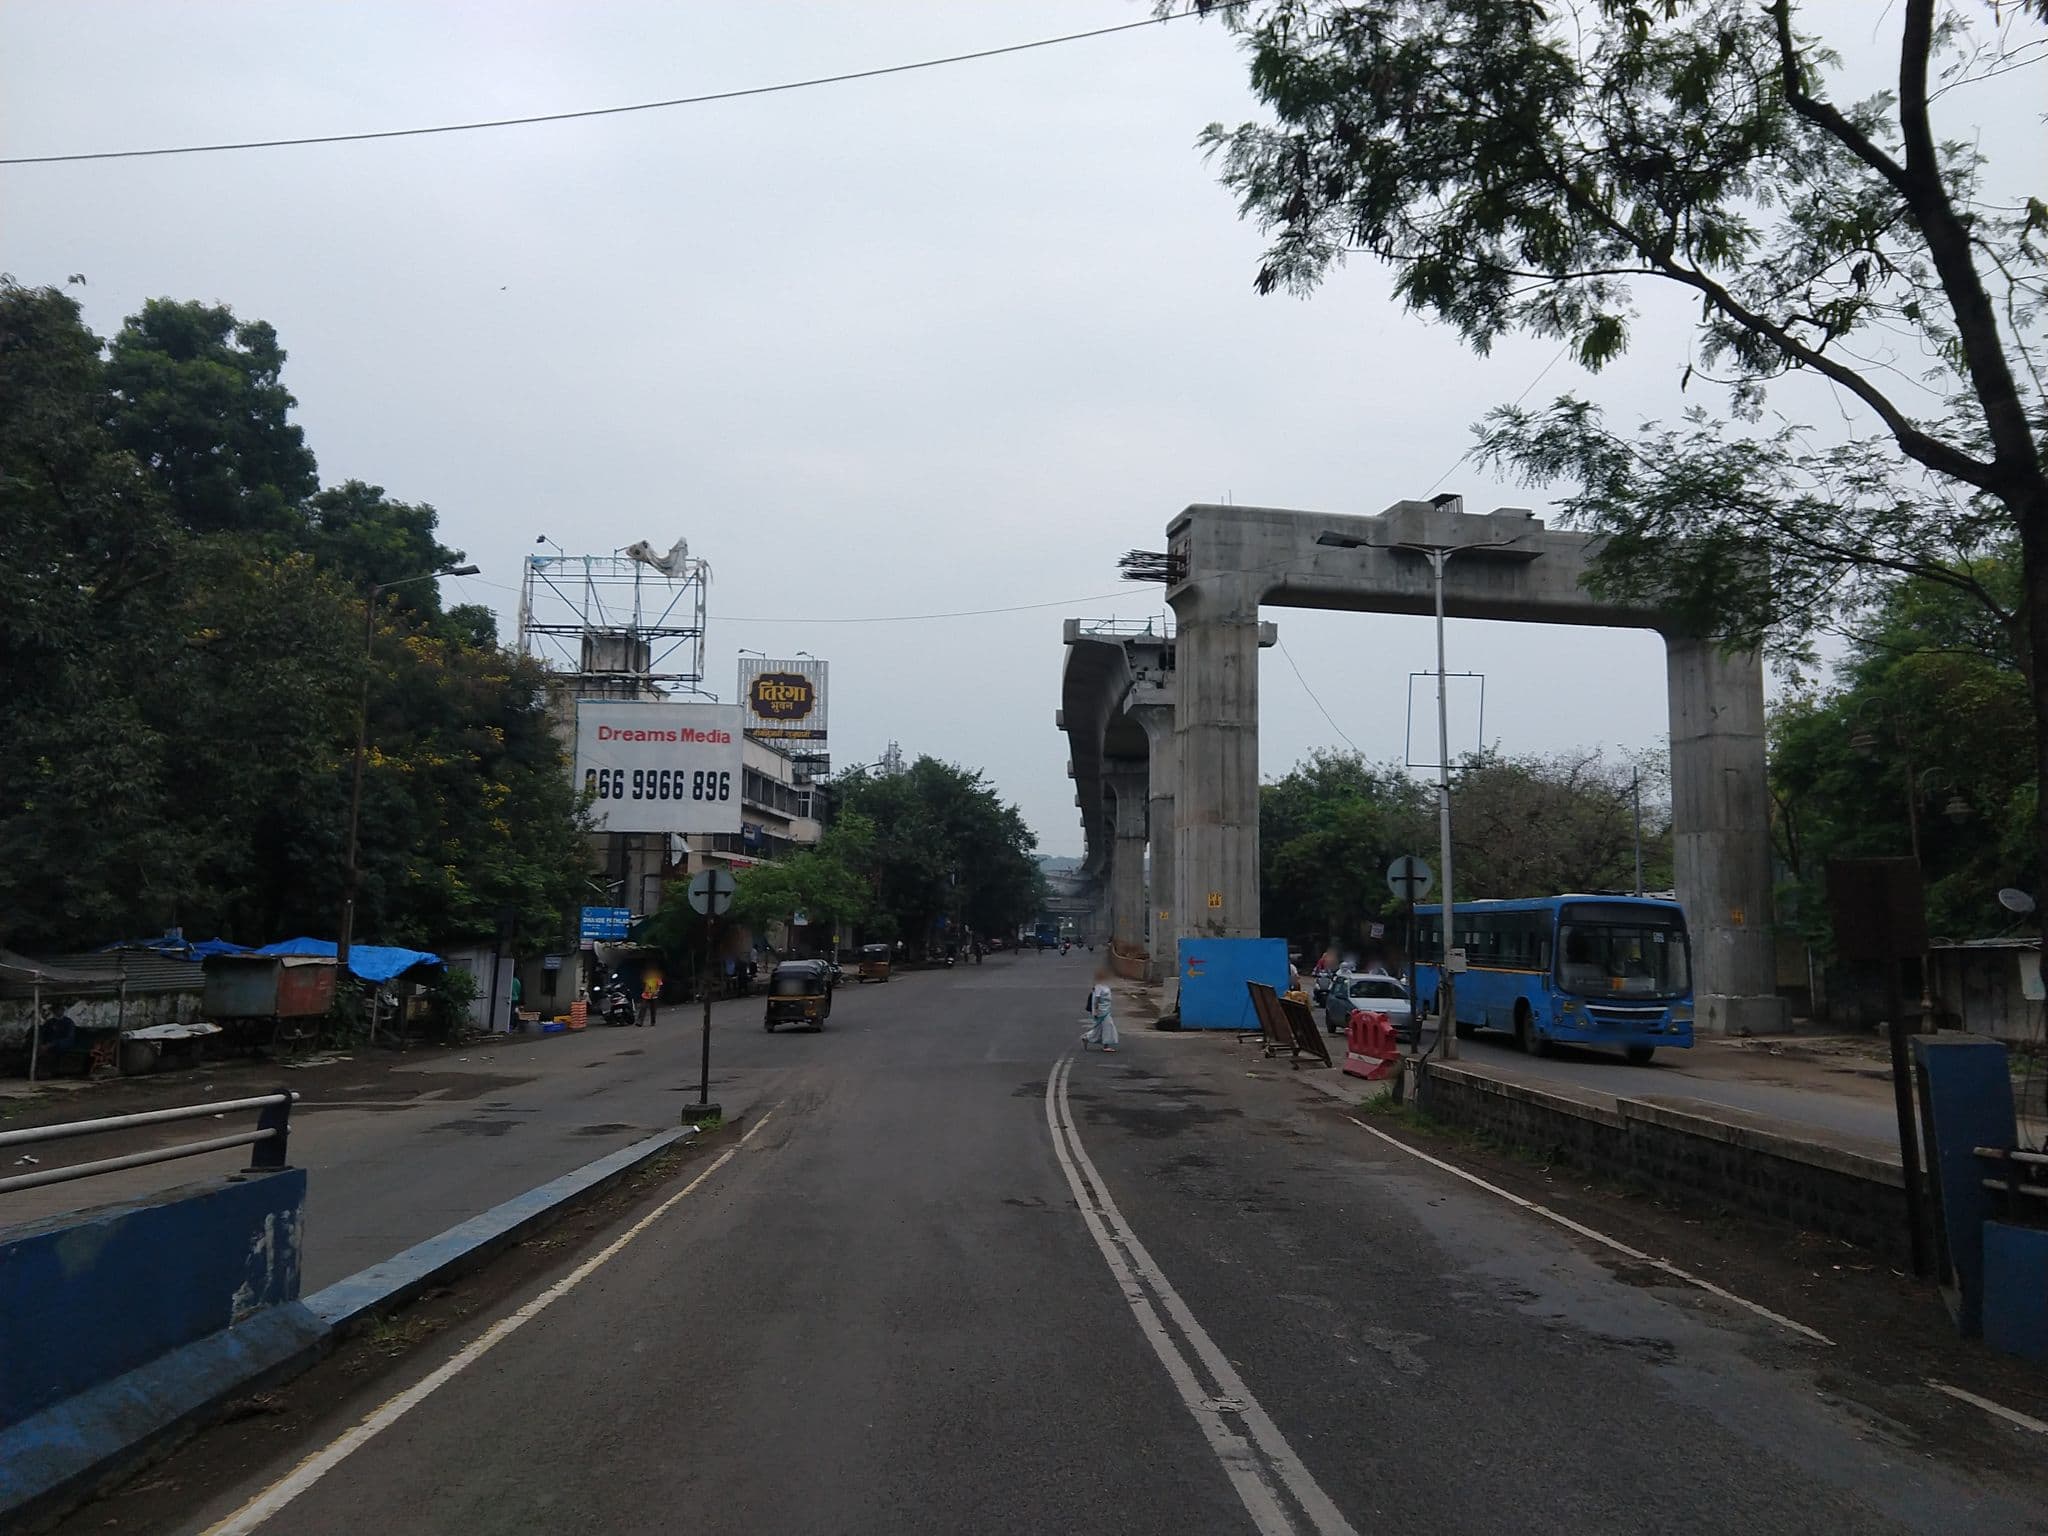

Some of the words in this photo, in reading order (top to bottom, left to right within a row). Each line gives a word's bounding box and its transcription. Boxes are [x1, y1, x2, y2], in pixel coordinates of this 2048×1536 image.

[598, 726, 677, 742] Dreams
[681, 728, 731, 744] Media
[632, 770, 685, 800] 9966
[693, 771, 730, 801] 896
